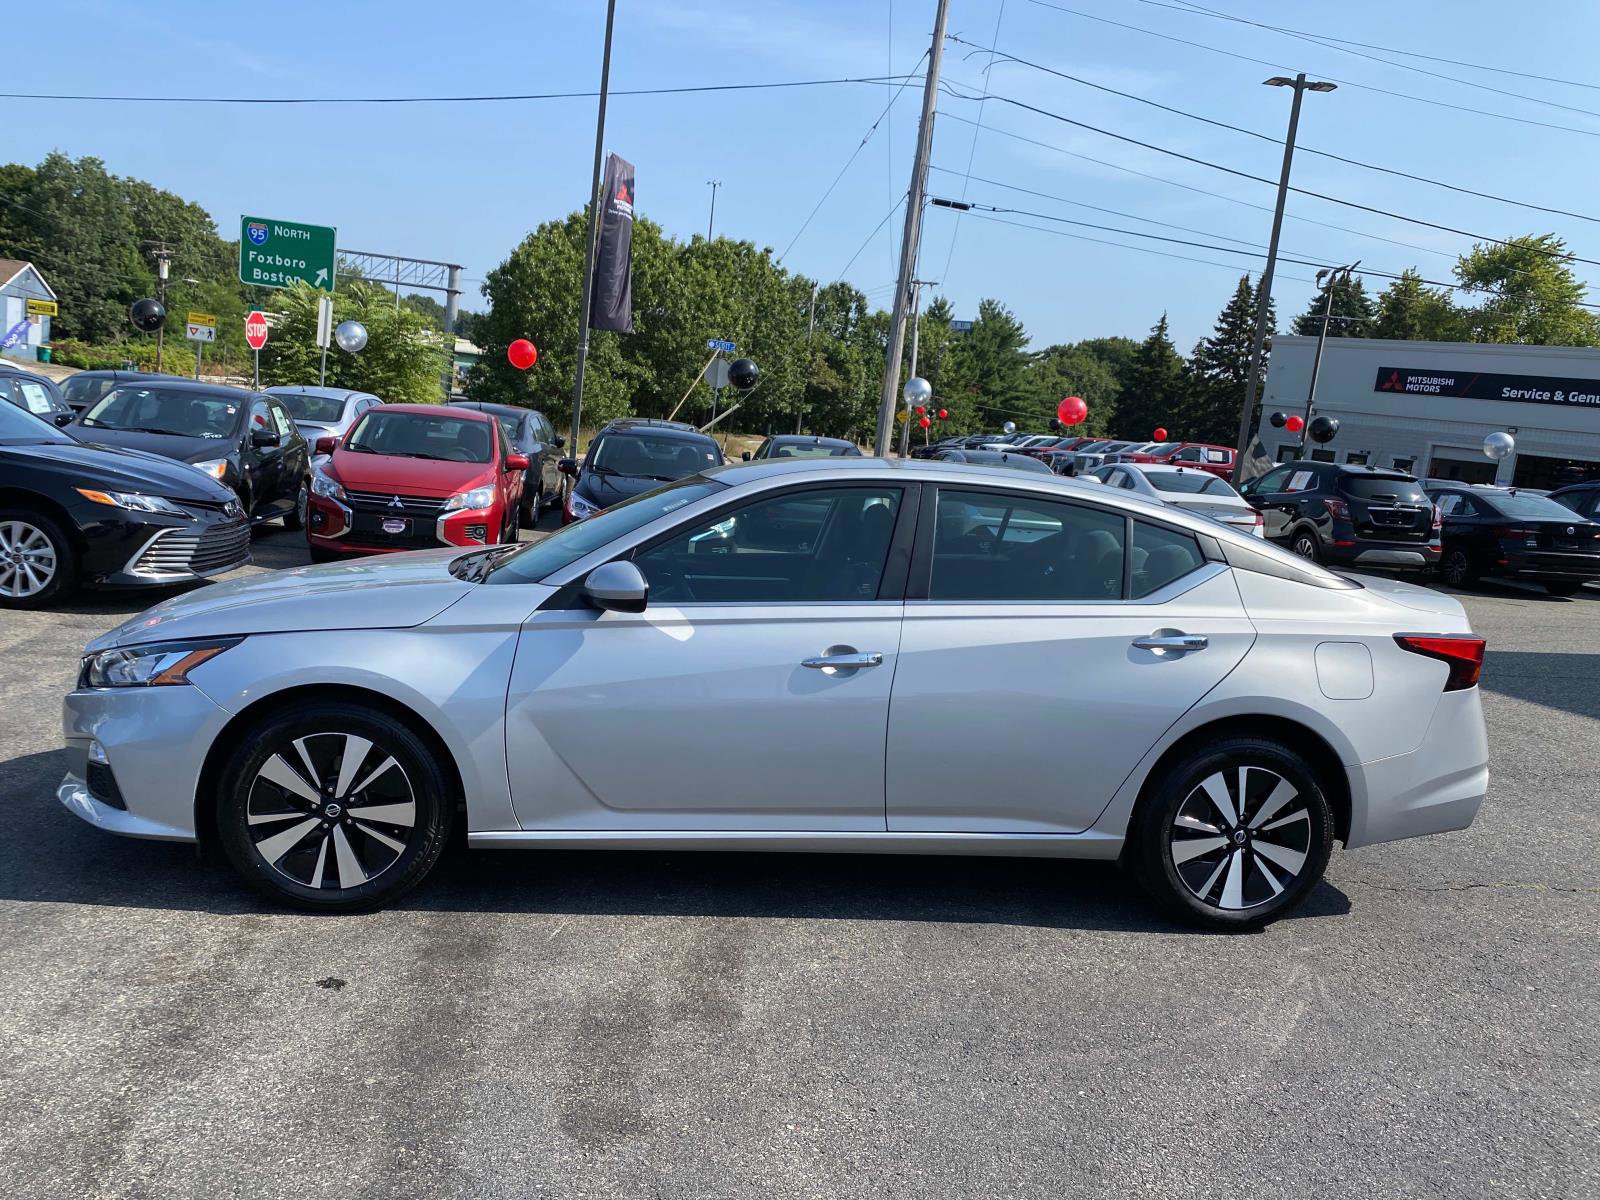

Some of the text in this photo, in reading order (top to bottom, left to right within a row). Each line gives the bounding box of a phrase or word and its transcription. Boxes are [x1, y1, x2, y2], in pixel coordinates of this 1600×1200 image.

[251, 228, 265, 240] 95
[274, 225, 311, 240] NORTH
[248, 251, 306, 268] Foxboro
[247, 323, 266, 337] STOP
[1407, 376, 1455, 386] MITSUBISHI
[1405, 384, 1441, 393] MOTORS
[1501, 387, 1551, 400] Service
[1553, 390, 1565, 402] &
